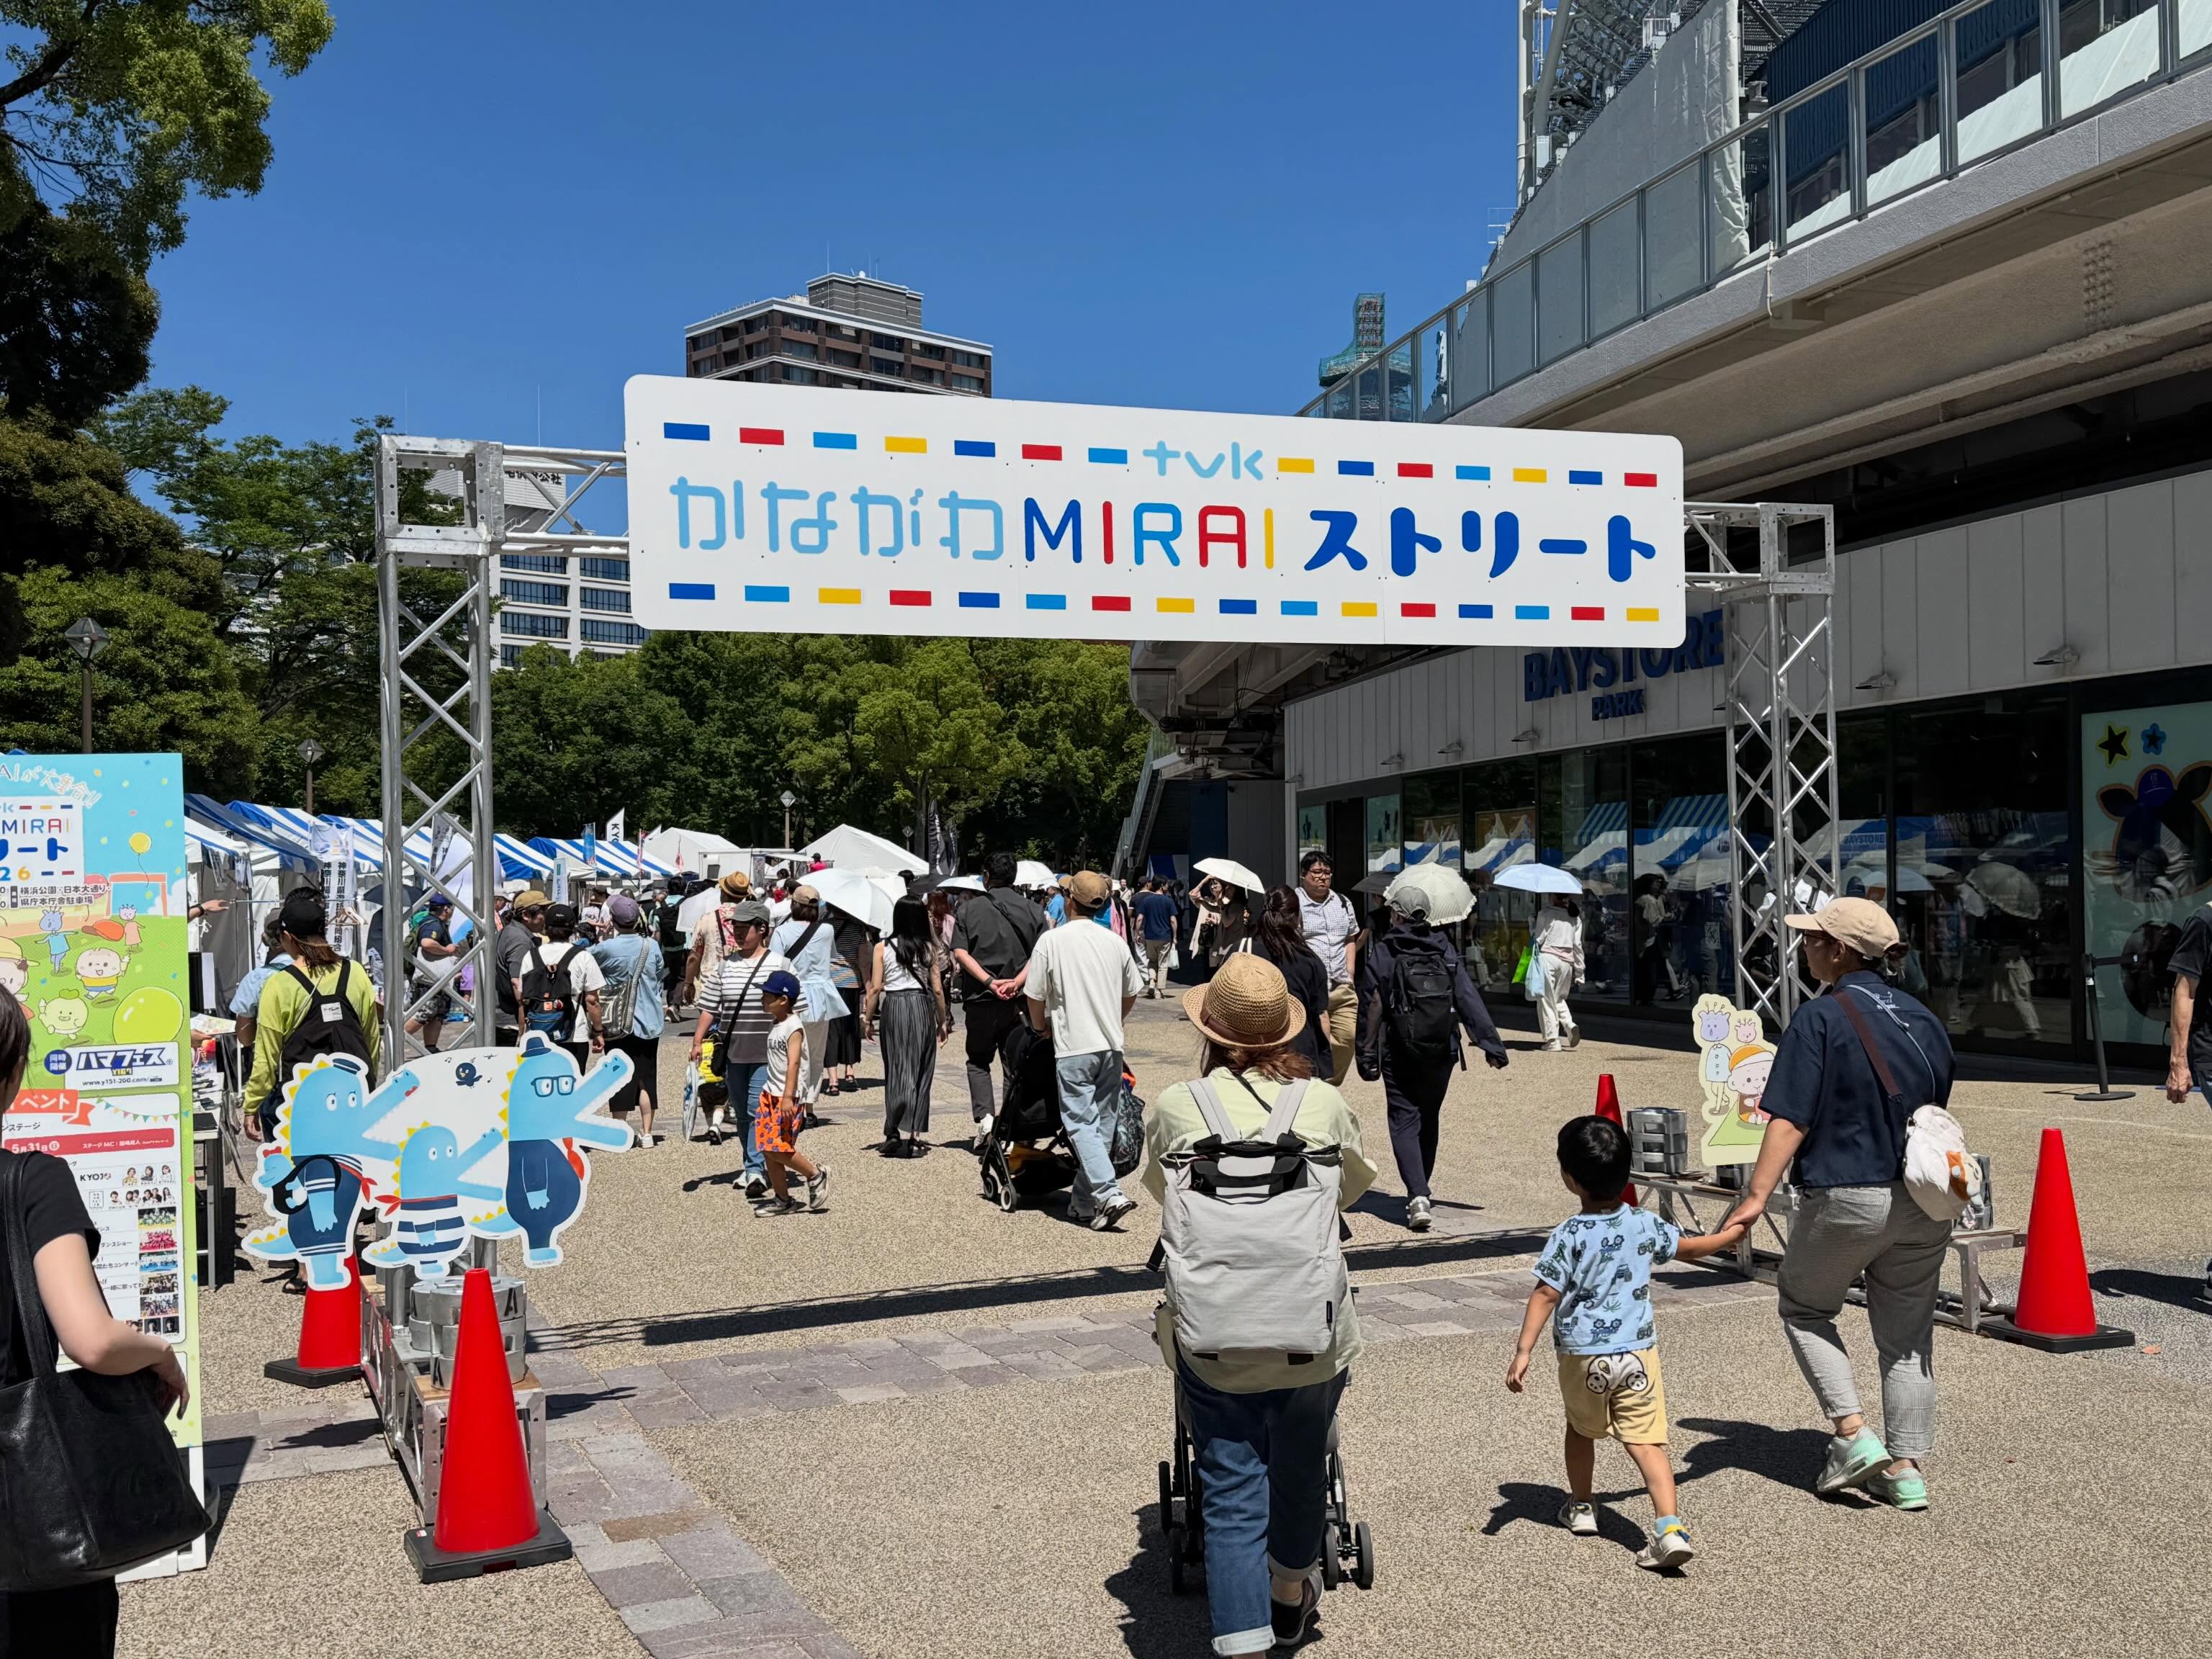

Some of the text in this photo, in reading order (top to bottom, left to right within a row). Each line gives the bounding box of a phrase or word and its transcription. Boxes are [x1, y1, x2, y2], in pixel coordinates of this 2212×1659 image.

[1143, 441, 1263, 481] tvk
[1592, 689, 1645, 721] PARK
[2, 818, 70, 835] MIRAI
